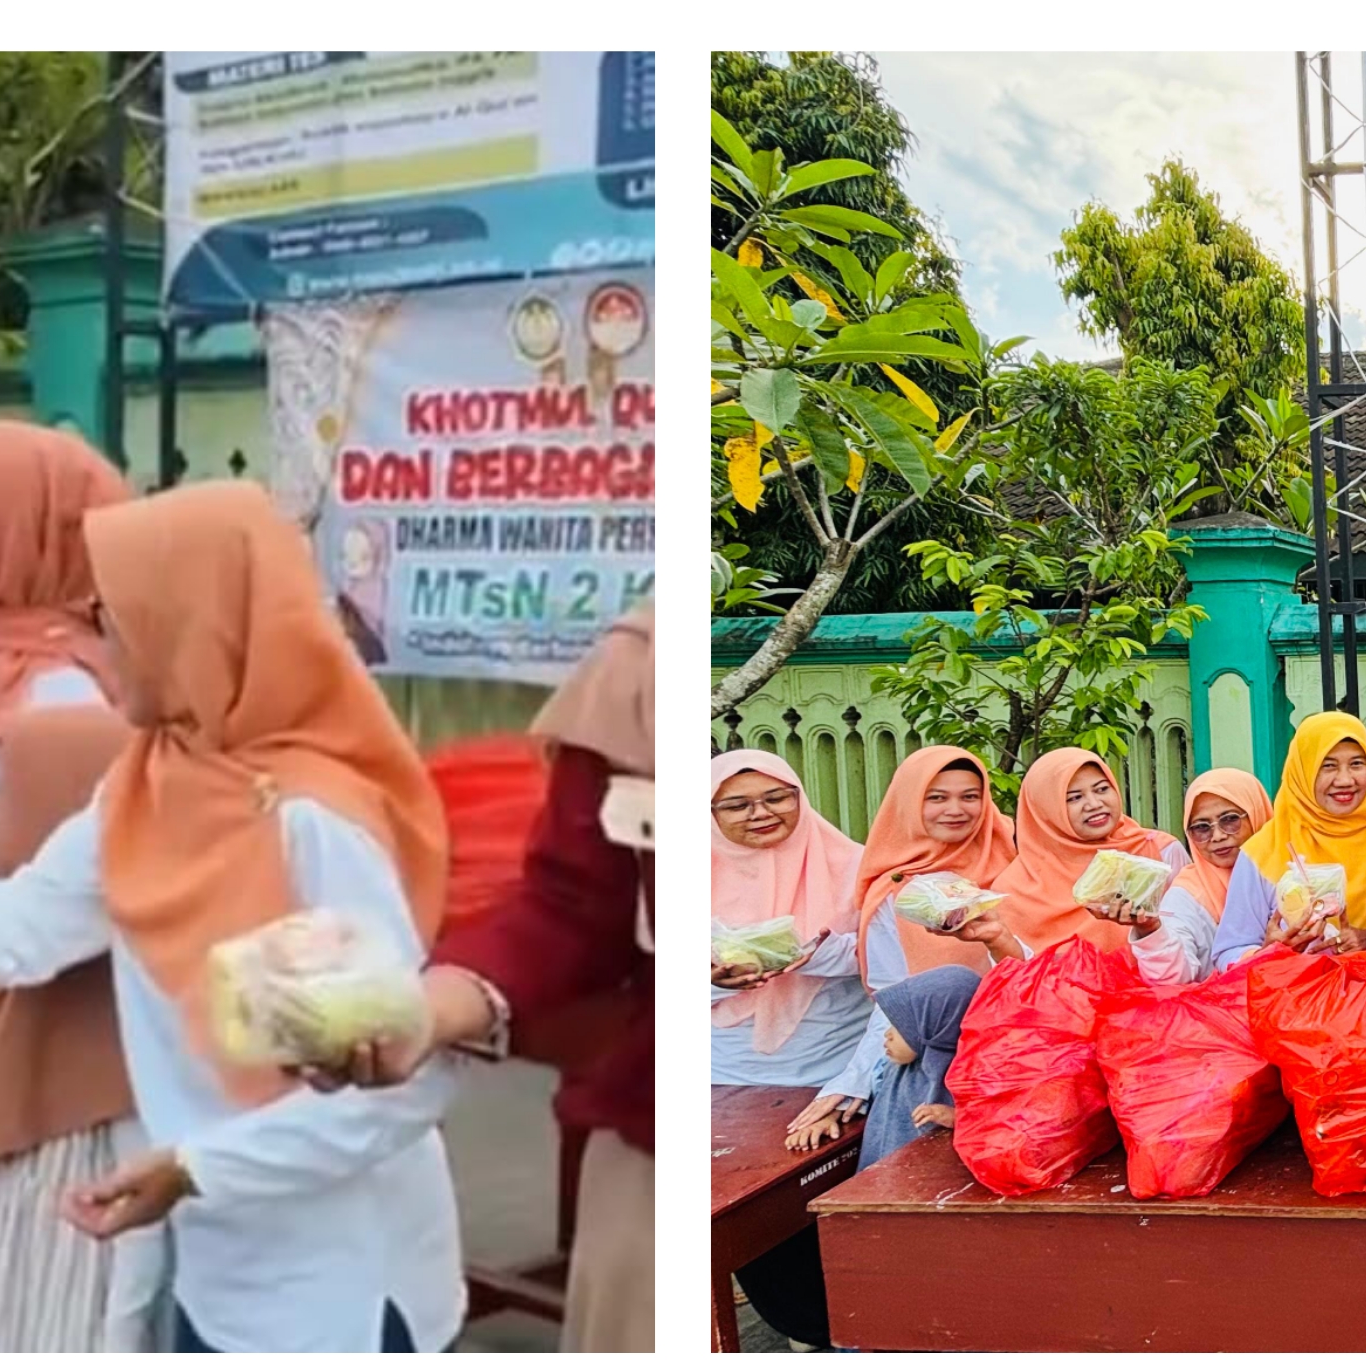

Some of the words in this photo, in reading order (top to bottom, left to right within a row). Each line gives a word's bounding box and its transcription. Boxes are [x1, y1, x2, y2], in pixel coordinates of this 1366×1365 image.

[407, 387, 595, 434] KHOTMUL
[342, 450, 432, 501] DAN
[397, 517, 492, 552] DHARMA
[499, 517, 591, 552] WANITA
[411, 569, 548, 619] MTsN
[567, 570, 599, 621] 2
[800, 1157, 840, 1186] KOMITE
